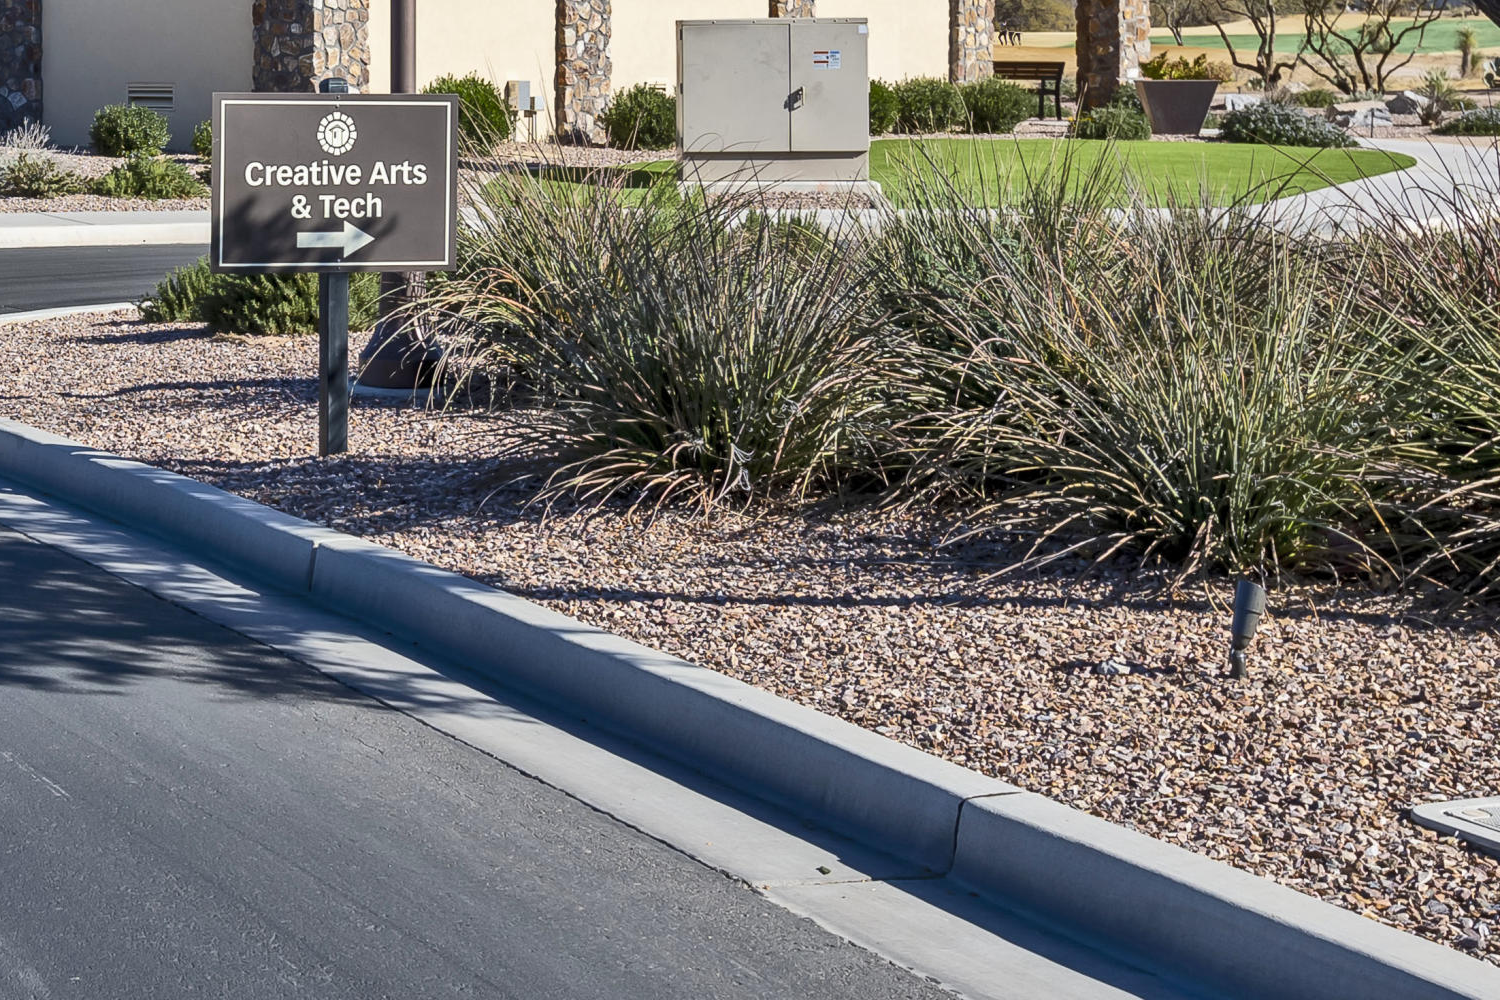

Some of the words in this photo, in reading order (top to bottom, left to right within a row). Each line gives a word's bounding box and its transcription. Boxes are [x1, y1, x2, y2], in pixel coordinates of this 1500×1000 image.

[244, 160, 361, 186] Creative
[368, 160, 427, 185] Arts
[291, 194, 311, 219] &
[318, 193, 382, 218] Tech
